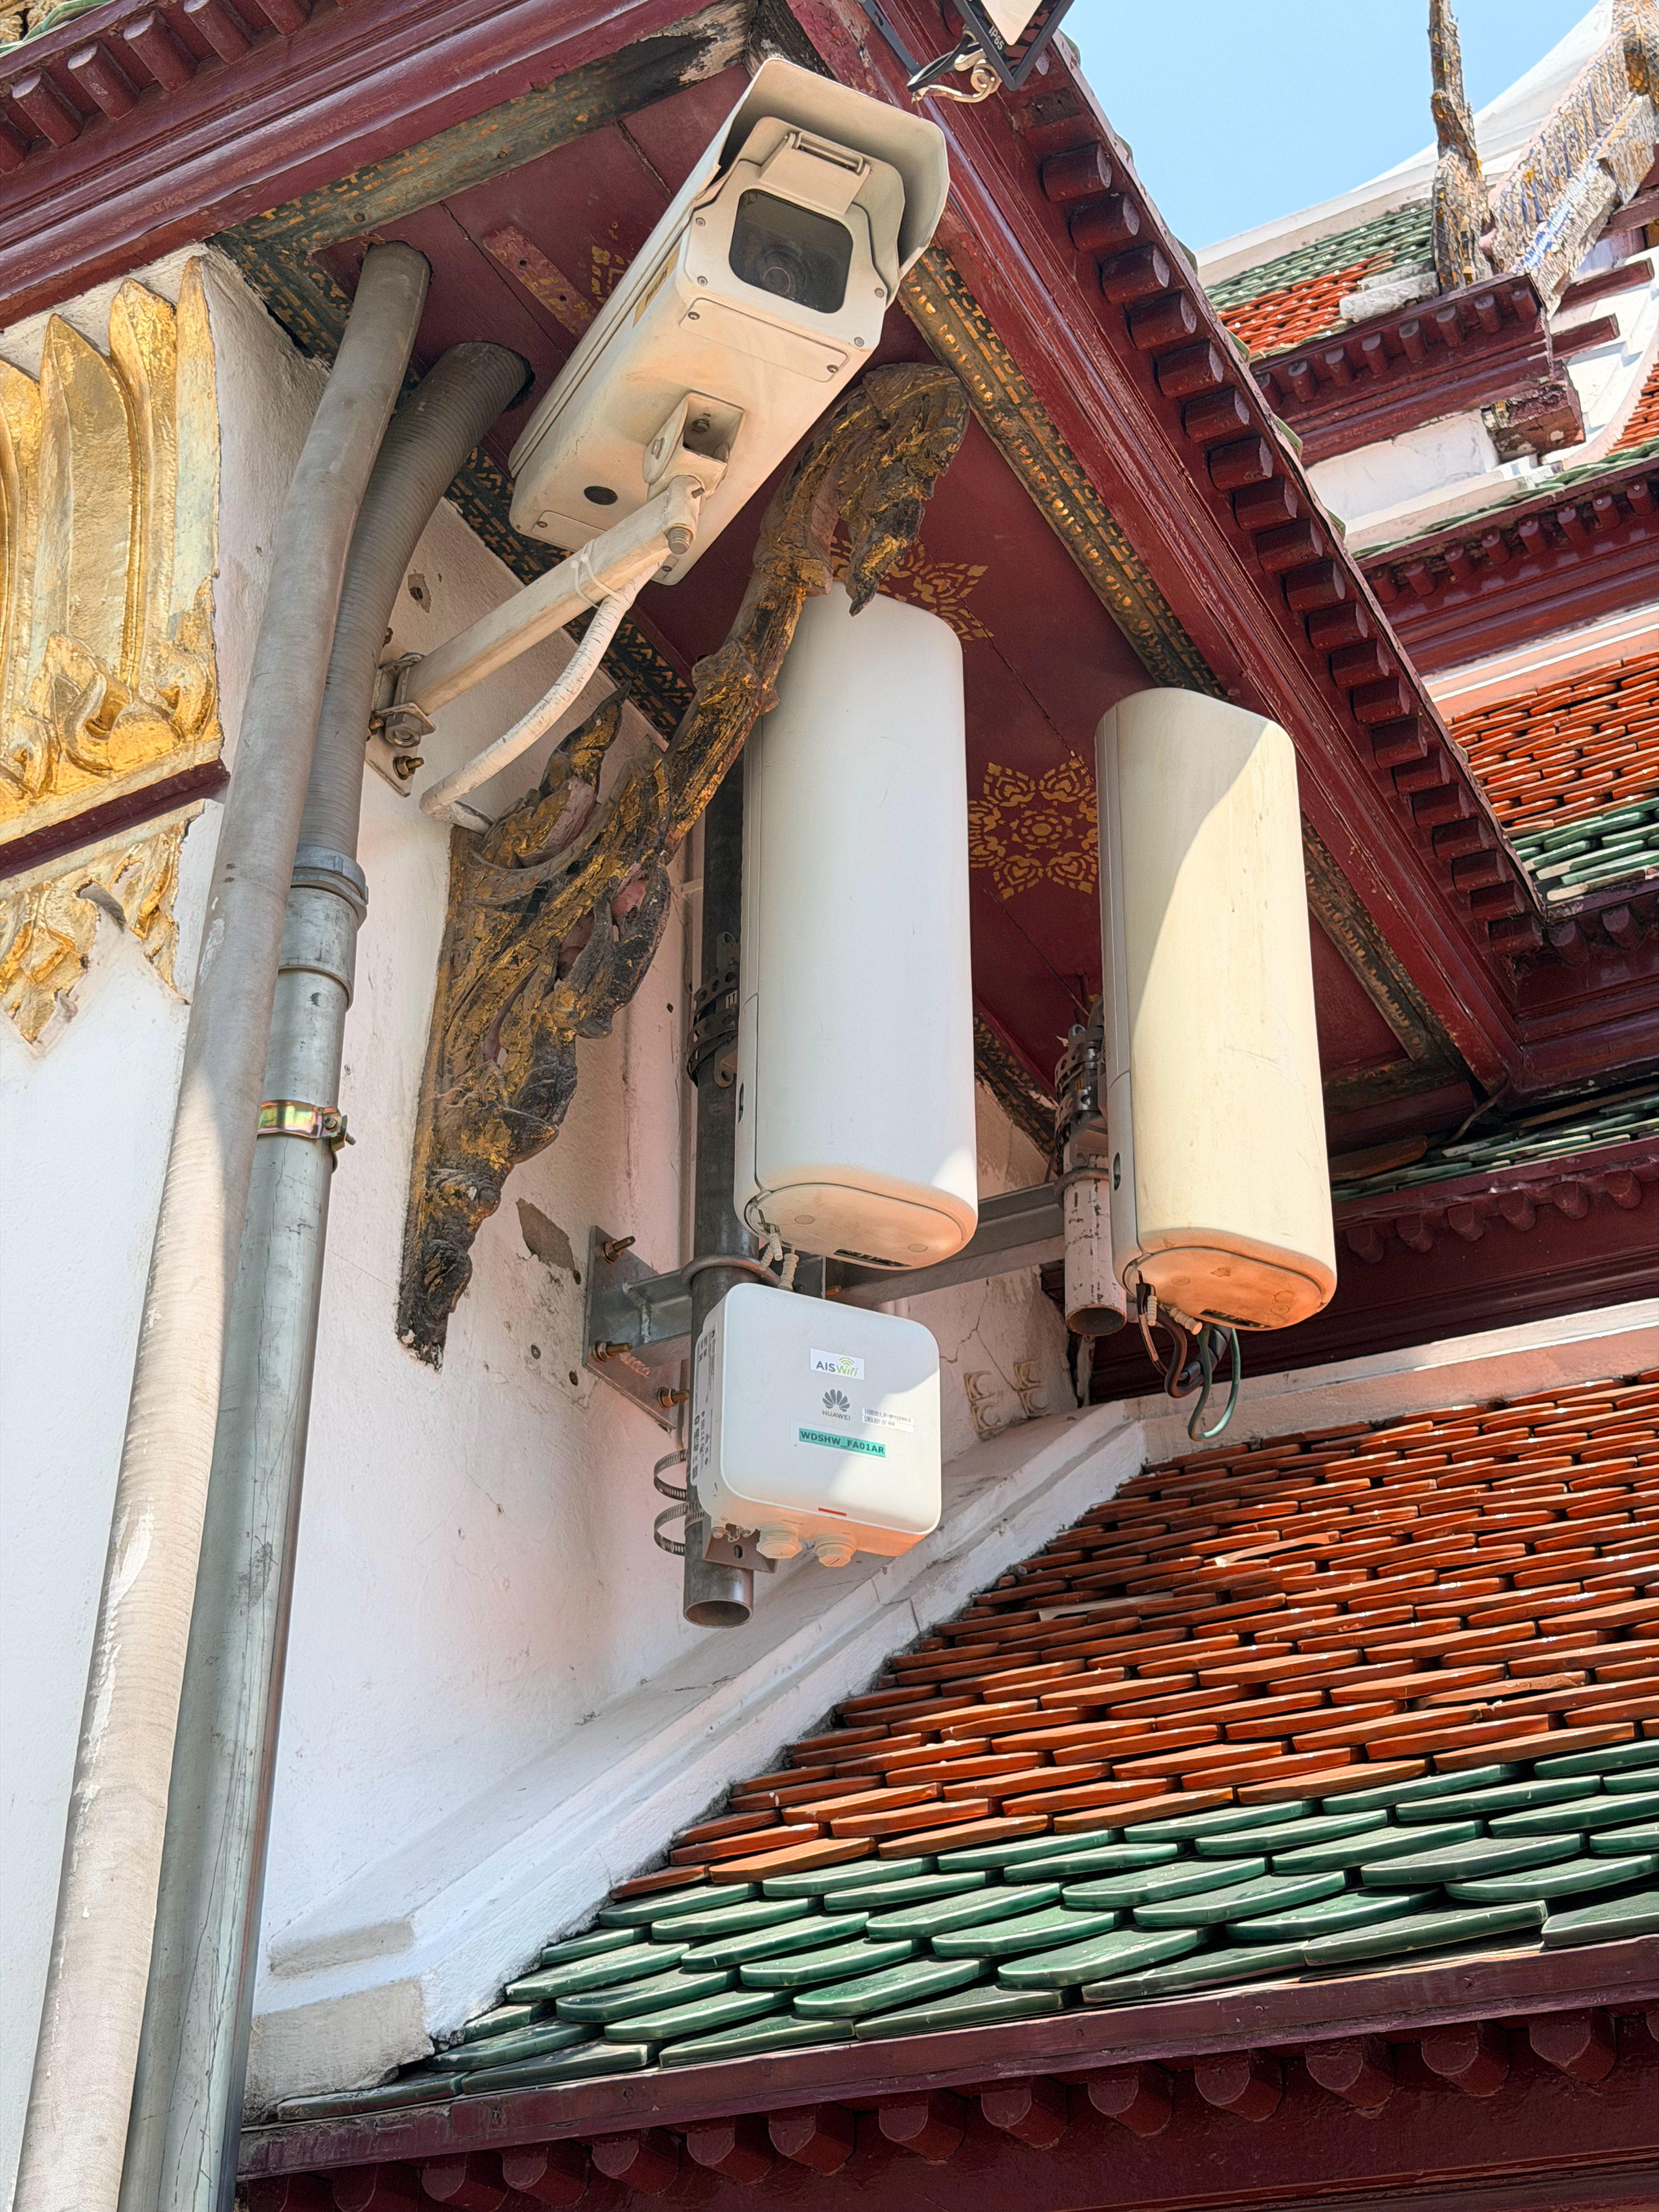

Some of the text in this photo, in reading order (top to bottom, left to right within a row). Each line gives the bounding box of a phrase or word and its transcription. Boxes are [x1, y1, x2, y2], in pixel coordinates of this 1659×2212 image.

[988, 25, 1005, 50] IP65
[822, 1409, 851, 1421] HUAWEI
[800, 1430, 885, 1454] WDSHW_FA01AR
